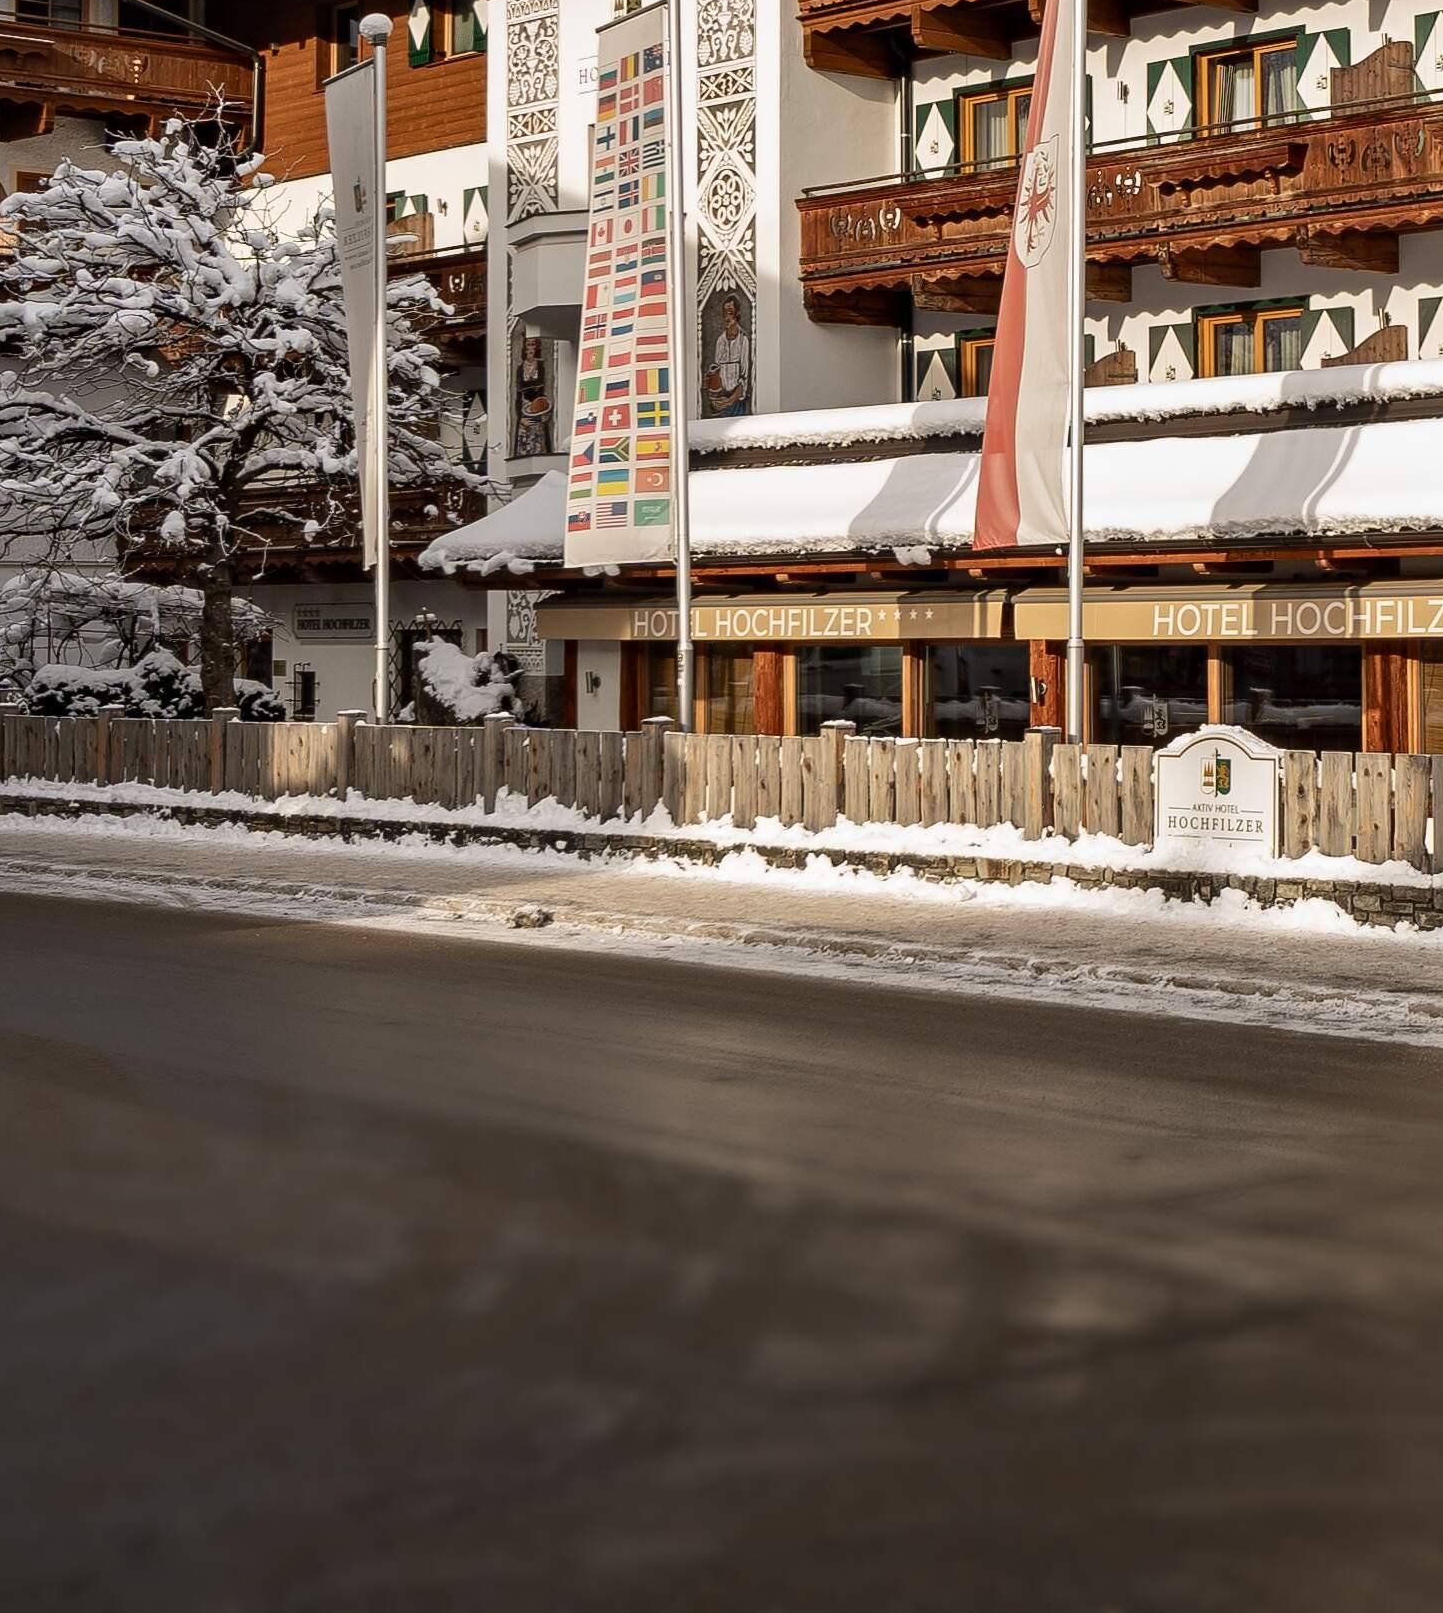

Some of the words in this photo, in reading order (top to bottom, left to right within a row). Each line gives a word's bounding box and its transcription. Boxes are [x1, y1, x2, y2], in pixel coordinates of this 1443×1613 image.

[715, 607, 873, 637] HOCHFILZER
[1152, 602, 1259, 636] HOTEL
[1191, 804, 1213, 812] AKTIV
[1215, 804, 1240, 814] HOTEL
[1168, 816, 1264, 833] HOCHFILZER
